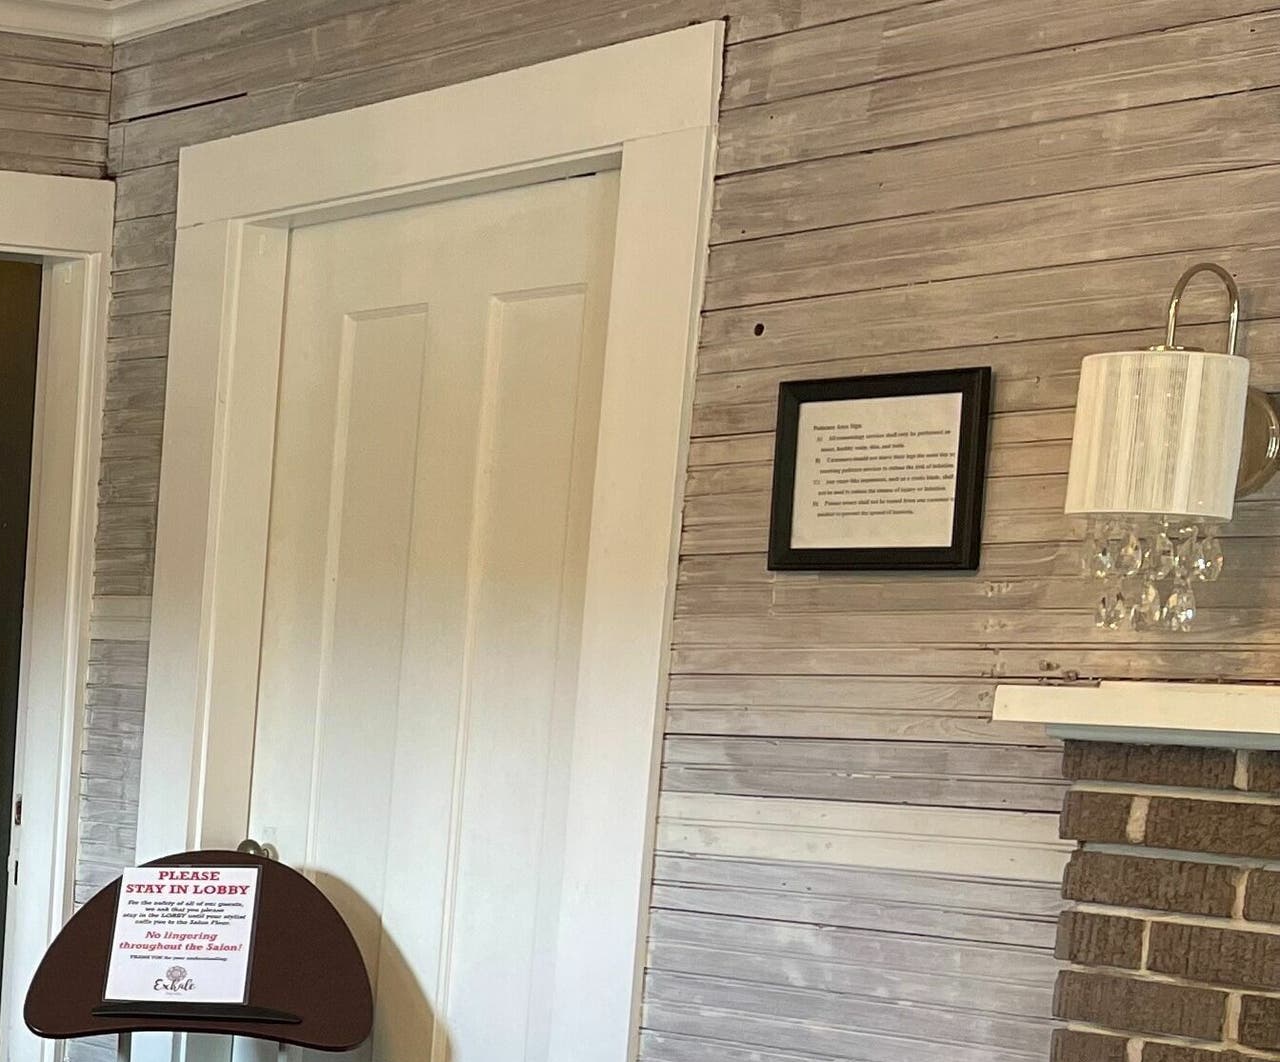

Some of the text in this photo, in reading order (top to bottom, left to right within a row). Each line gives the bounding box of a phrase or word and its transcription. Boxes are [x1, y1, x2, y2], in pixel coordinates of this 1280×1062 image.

[159, 870, 220, 881] PLEASE
[125, 884, 250, 895] STAY IN LOBBY
[145, 931, 217, 941] No lingering
[120, 942, 242, 952] throughout the Salon!
[153, 978, 196, 992] Exhale
